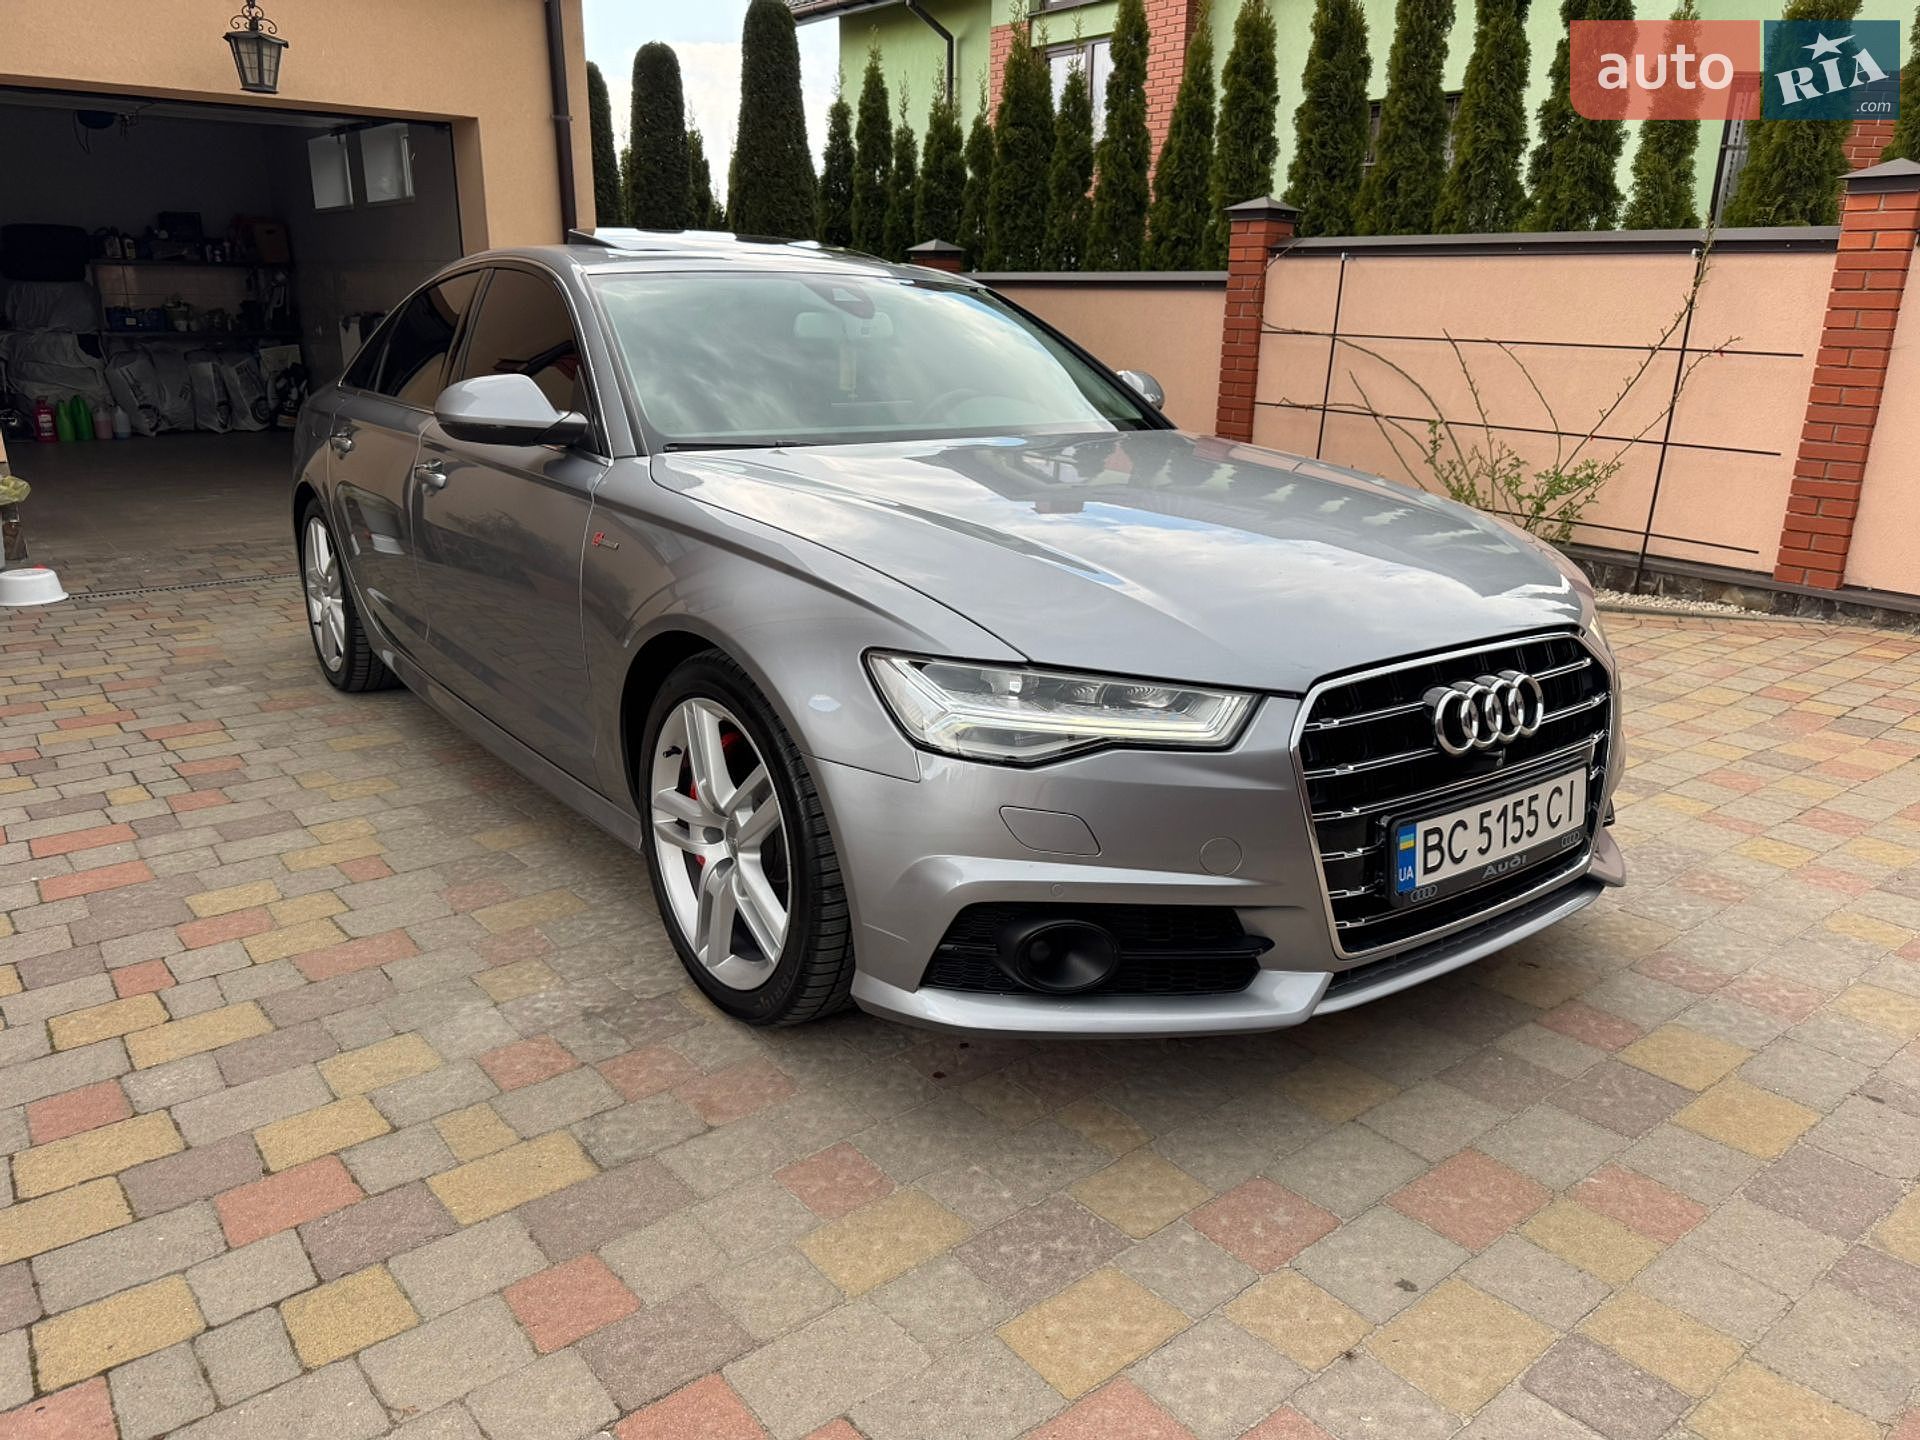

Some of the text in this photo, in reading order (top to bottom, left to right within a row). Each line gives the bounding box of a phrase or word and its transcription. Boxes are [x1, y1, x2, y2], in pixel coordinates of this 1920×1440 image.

[1422, 779, 1574, 875] BC 5155 CI
[1399, 865, 1414, 882] UA
[1482, 855, 1527, 879] Audi
